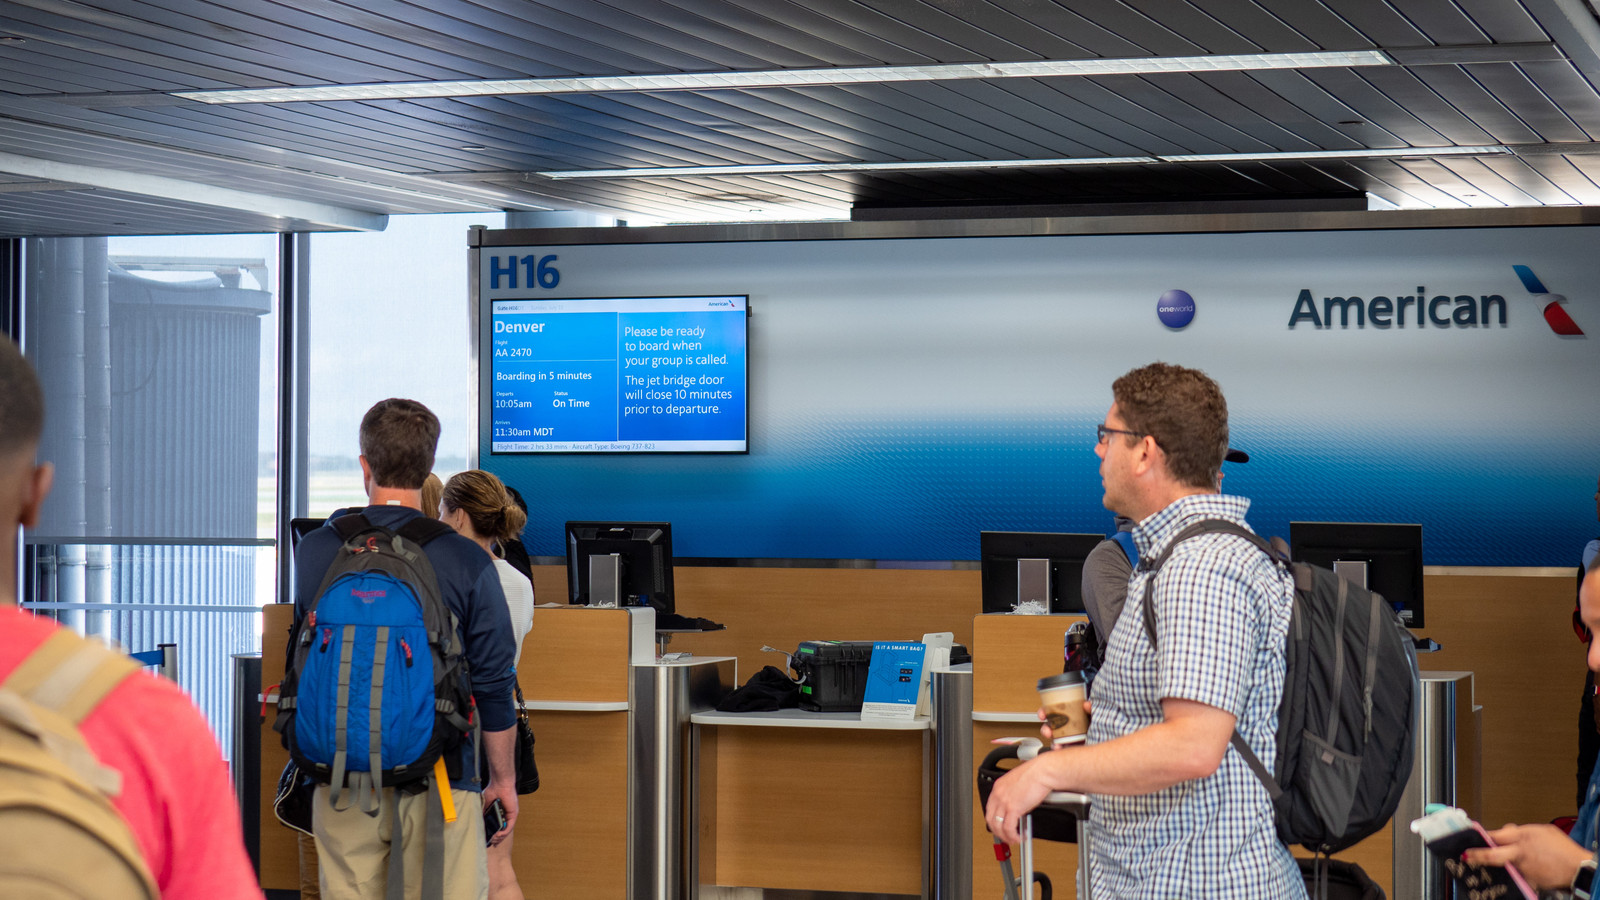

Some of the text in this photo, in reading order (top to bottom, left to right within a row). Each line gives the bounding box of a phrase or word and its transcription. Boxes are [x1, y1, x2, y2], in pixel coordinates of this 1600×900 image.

[491, 255, 560, 289] H16
[1288, 287, 1506, 328] American
[494, 320, 545, 333] Denver
[624, 326, 706, 339] Please be ready
[625, 340, 702, 351] to board when
[495, 348, 532, 356] AA 2470
[625, 354, 728, 368] your group is called.
[496, 371, 592, 382] Boarding in 5 minutes
[625, 374, 724, 388] The jet bridge door
[625, 389, 732, 400] will close 10 minutes
[495, 400, 532, 408] 10:05am
[553, 399, 590, 408] On Time
[624, 404, 721, 417] prior to departure.
[495, 428, 554, 436] 11:30am MDT
